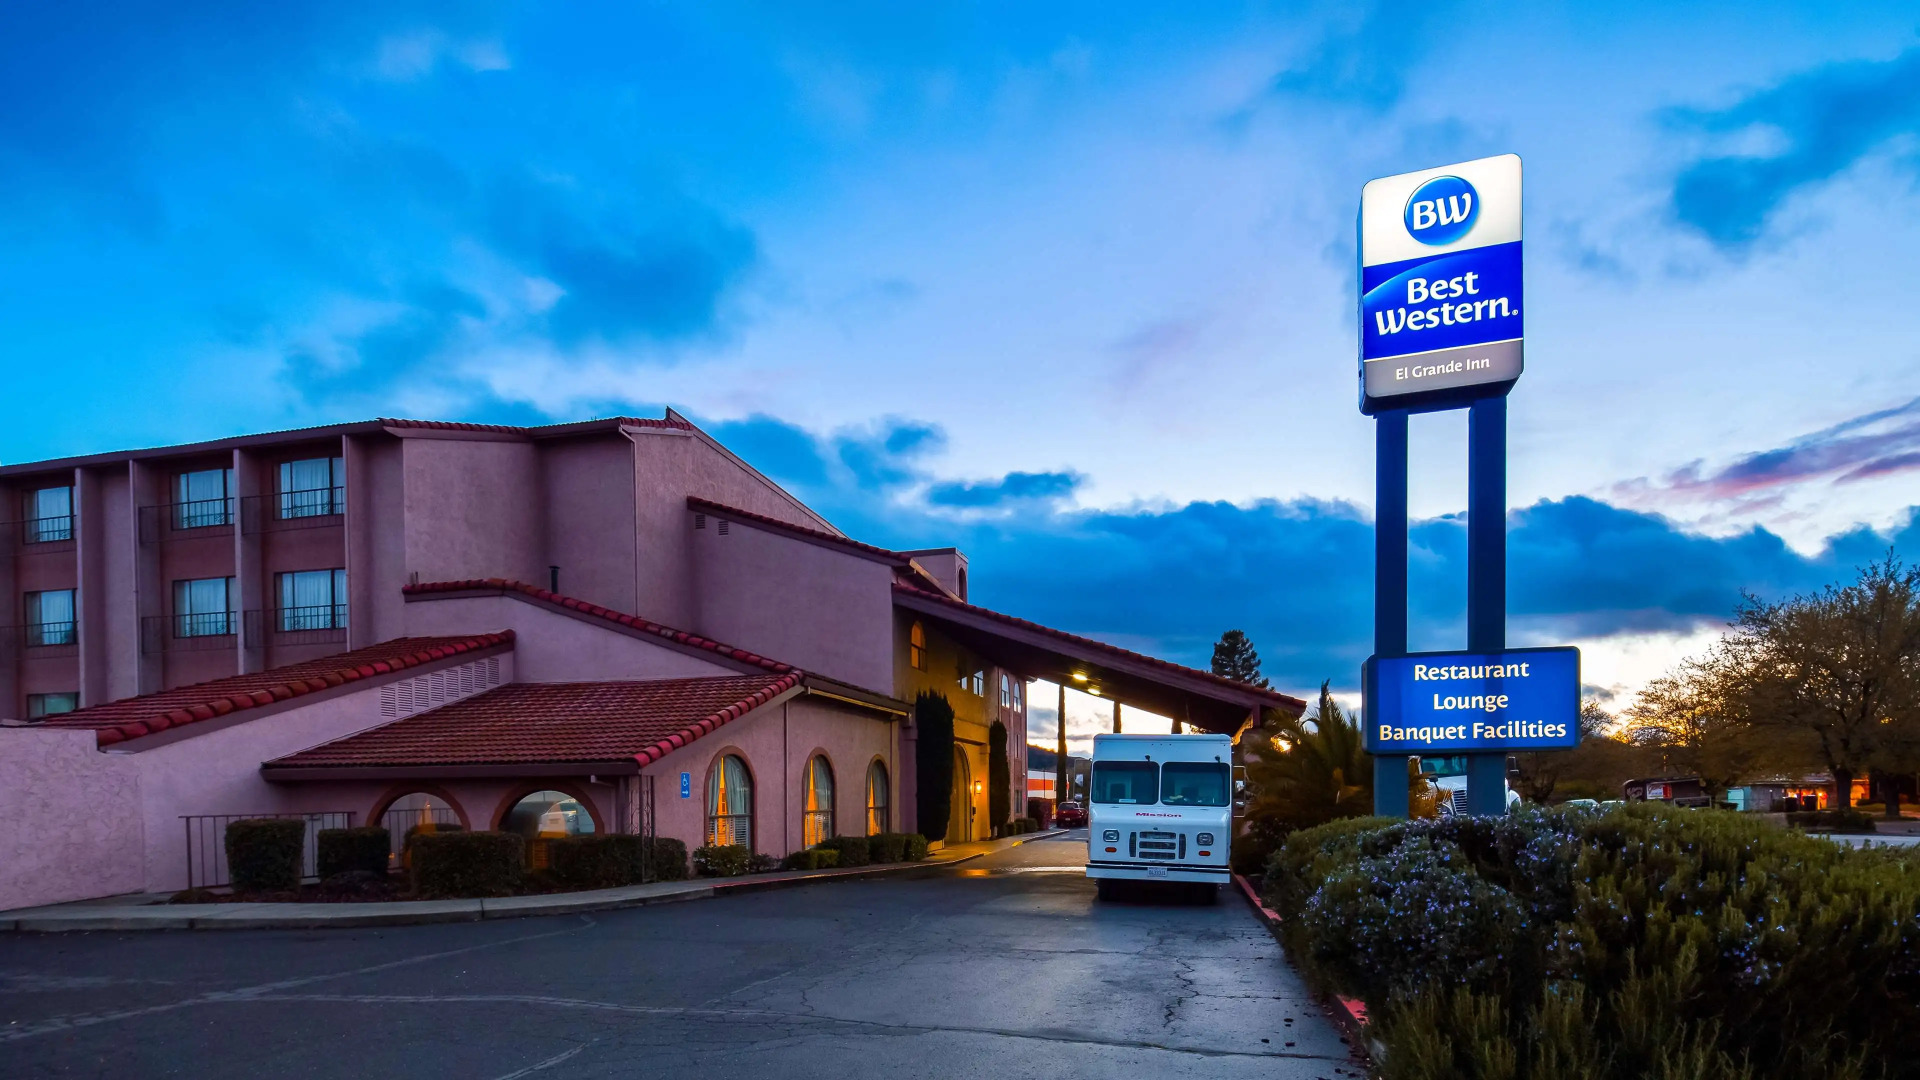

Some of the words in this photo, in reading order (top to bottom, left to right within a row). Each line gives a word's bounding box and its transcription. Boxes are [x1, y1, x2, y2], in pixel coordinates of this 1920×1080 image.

[1413, 192, 1472, 231] BW
[1407, 271, 1479, 304] Best
[1395, 368, 1409, 380] El
[1411, 361, 1463, 378] Grande
[1466, 357, 1490, 370] Inn
[1414, 662, 1530, 681] Restaurant
[1433, 693, 1509, 712] Lounge
[1379, 724, 1467, 744] Banquet
[1472, 720, 1567, 739] Facilities
